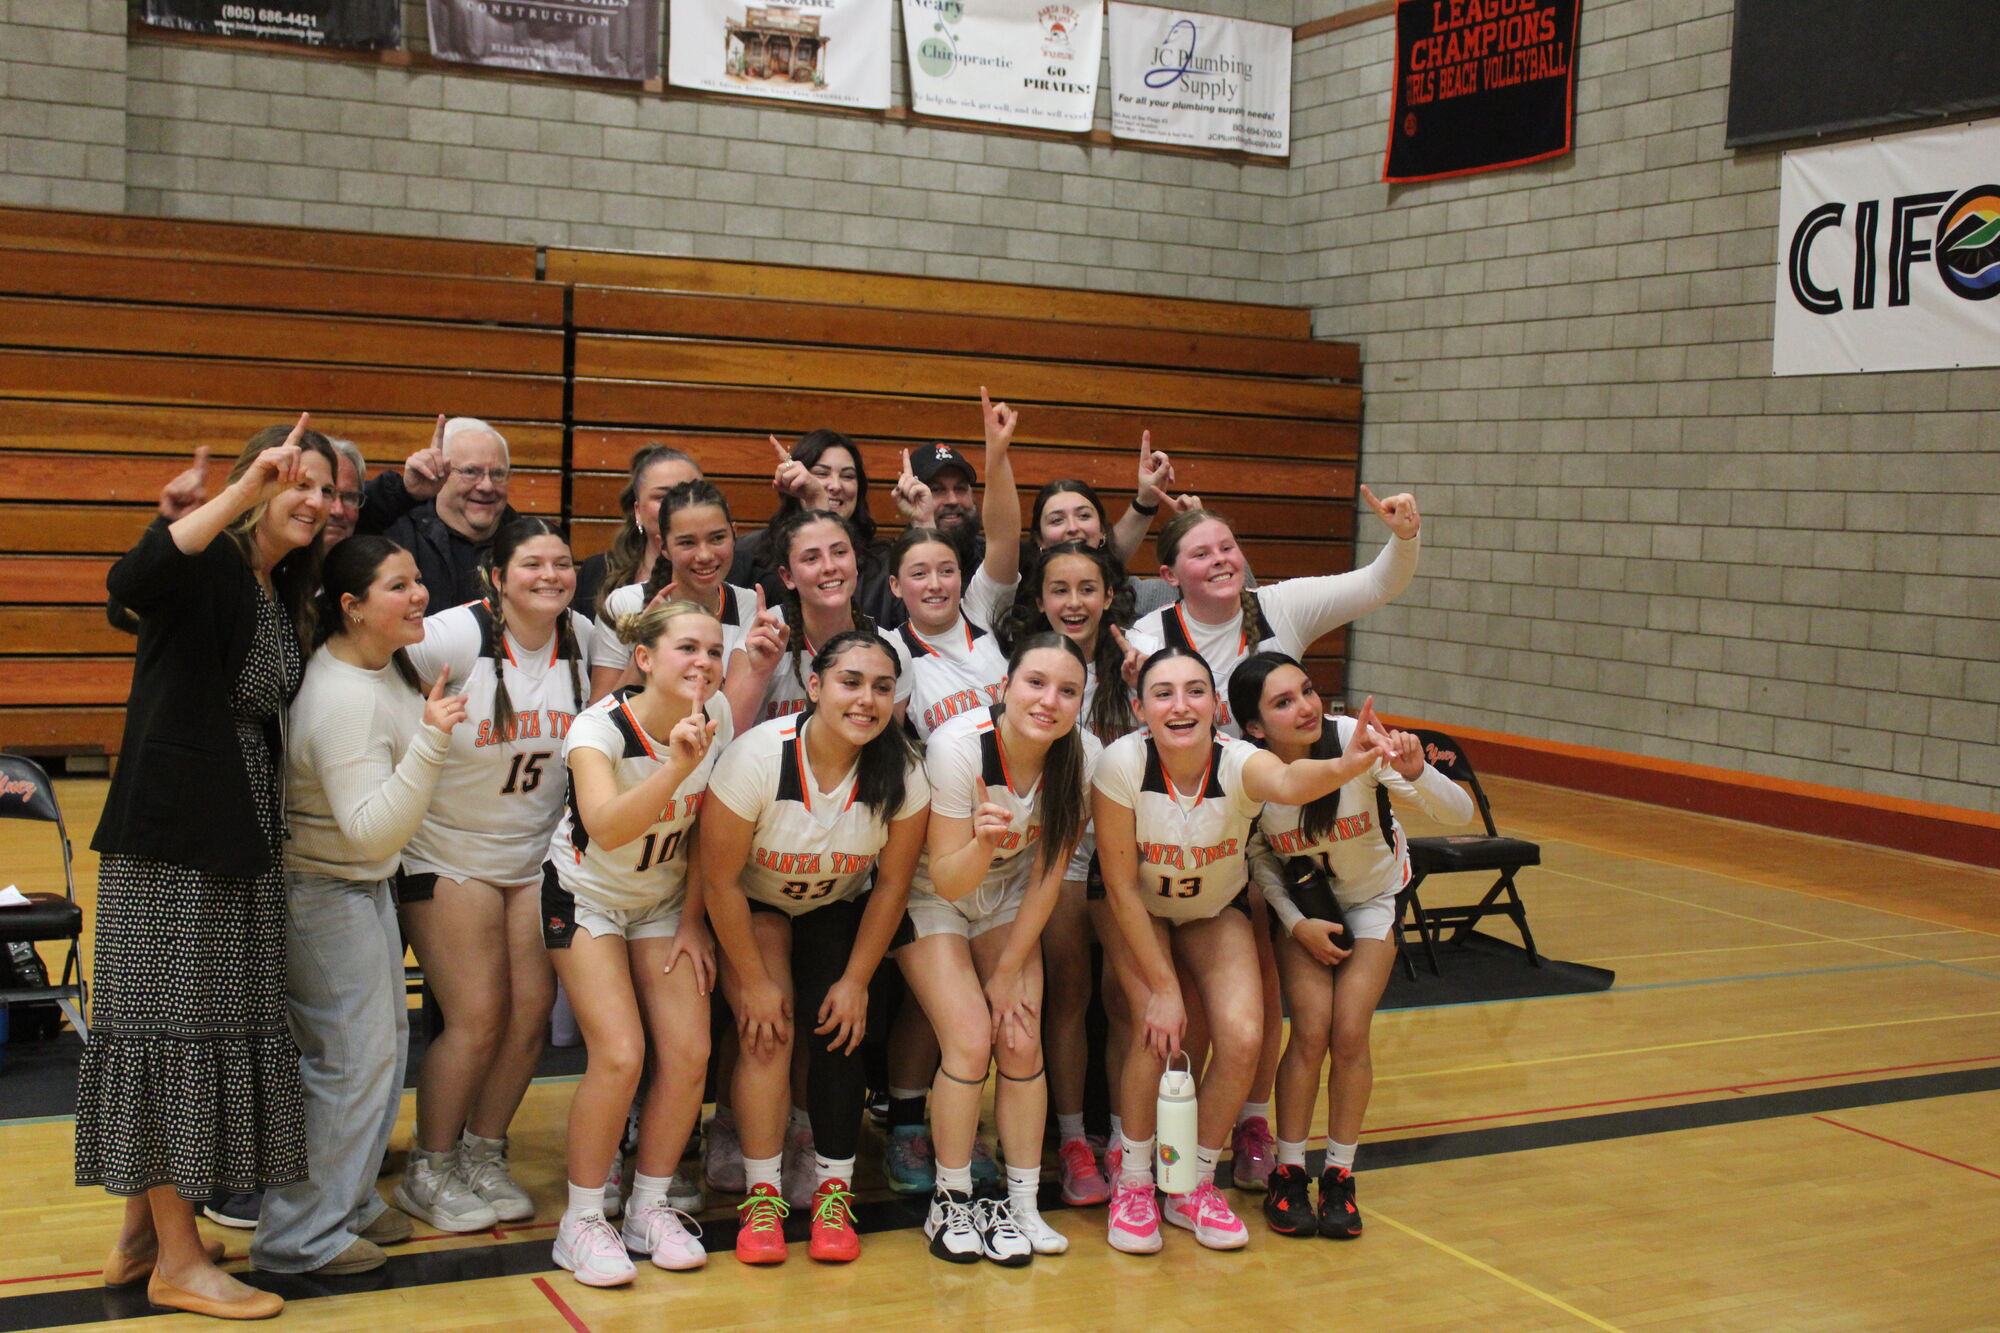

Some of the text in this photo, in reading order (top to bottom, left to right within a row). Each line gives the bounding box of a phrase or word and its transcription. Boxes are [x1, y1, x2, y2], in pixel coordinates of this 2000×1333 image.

[222, 4, 255, 22] (805)
[466, 1, 610, 27] CONSTRUCTION
[1410, 7, 1556, 72] CHAMPIONS
[921, 44, 1014, 70] Chiropractic
[1046, 65, 1067, 78] GO
[1150, 46, 1253, 82] JC Plumbing
[1439, 61, 1478, 101] BEACH
[1484, 42, 1567, 91] VOLLEYBALL
[1023, 77, 1091, 95] PIRATES!
[1179, 73, 1239, 102] Supply
[1118, 93, 1133, 103] For
[1135, 96, 1148, 106] all
[1149, 97, 1170, 108] your
[1172, 101, 1215, 115] plumbing
[1247, 110, 1275, 122] needs!
[1788, 190, 1959, 316] CIF
[767, 699, 806, 720] SAN
[923, 688, 982, 731] SANTA
[547, 709, 576, 740] YN
[500, 750, 554, 796] 15
[634, 830, 683, 873] 10
[755, 847, 822, 875] SANTA
[1137, 838, 1239, 871] NTA YNEZ
[780, 877, 838, 901] 23
[1157, 874, 1203, 899] 13
